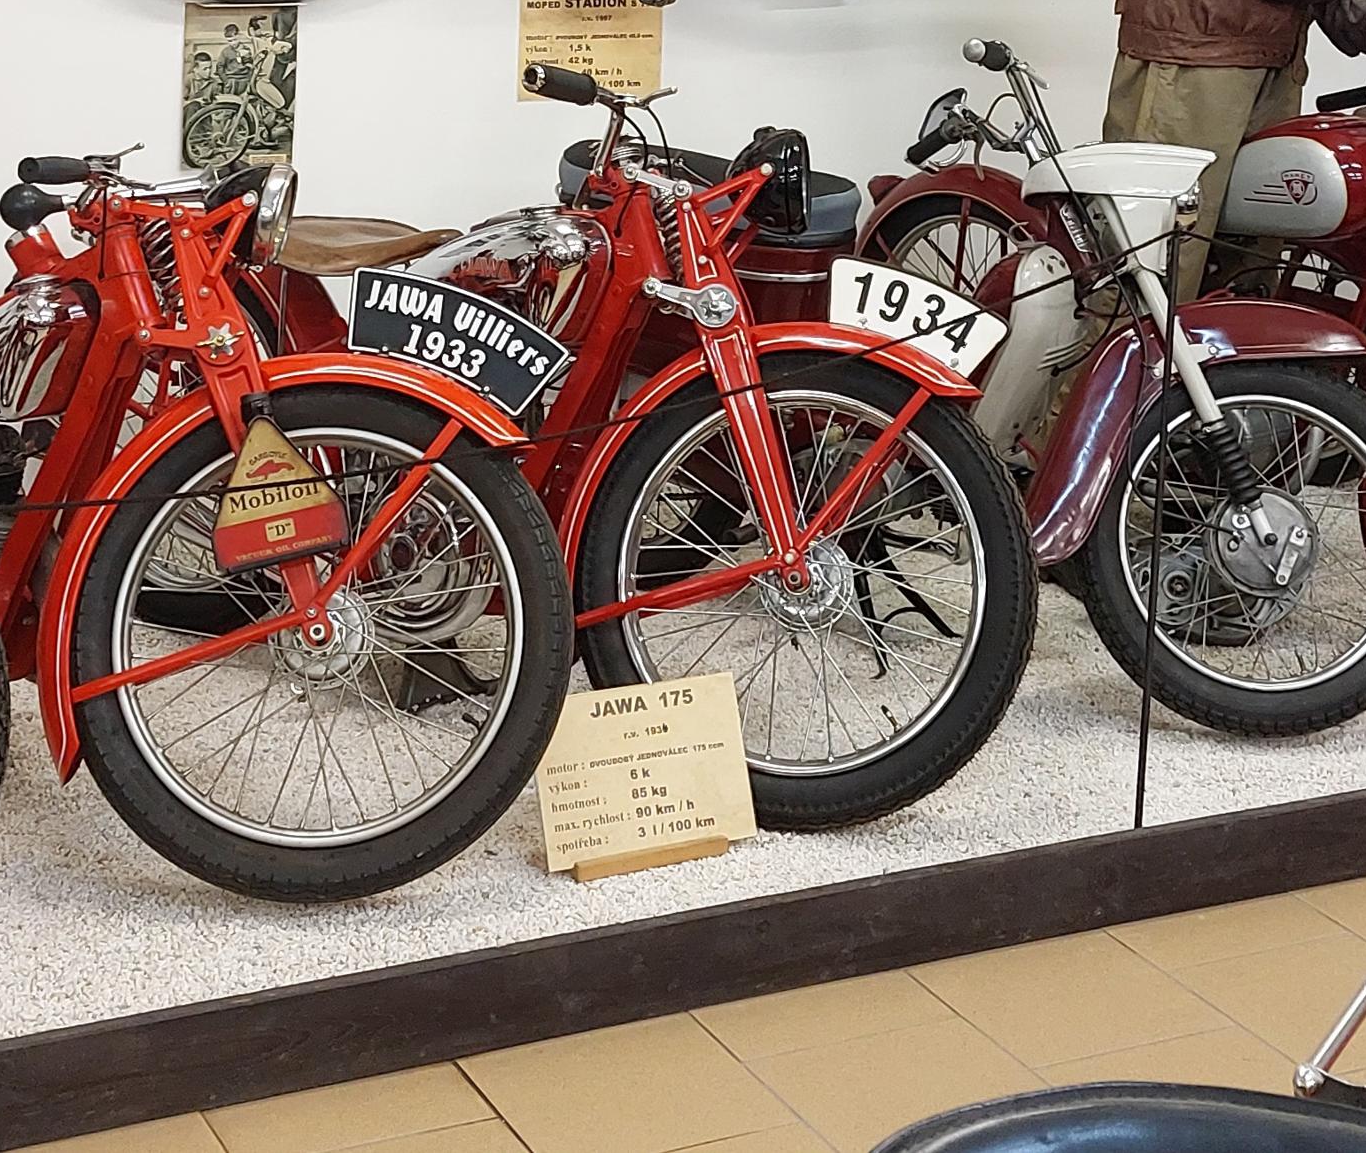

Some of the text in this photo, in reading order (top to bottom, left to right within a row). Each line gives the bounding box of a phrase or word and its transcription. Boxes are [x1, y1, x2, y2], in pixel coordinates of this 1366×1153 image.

[527, 1, 560, 9] MOPED
[569, 44, 583, 53] 1,5
[582, 57, 593, 65] kg
[854, 272, 978, 353] 1934
[364, 279, 551, 377] JAWA Villiers
[403, 324, 486, 379] 1933
[229, 482, 320, 513] Mobiloil
[276, 544, 291, 553] OIL
[590, 689, 693, 718] JAWA 175
[546, 762, 579, 776] motor
[693, 744, 706, 753] 175
[630, 769, 638, 780] 6
[642, 767, 650, 778] k
[551, 785, 667, 813] hmotnost 85 kg
[554, 799, 695, 833] max. rychlost 90 km h
[556, 816, 715, 854] spotřeba 3 100 km
